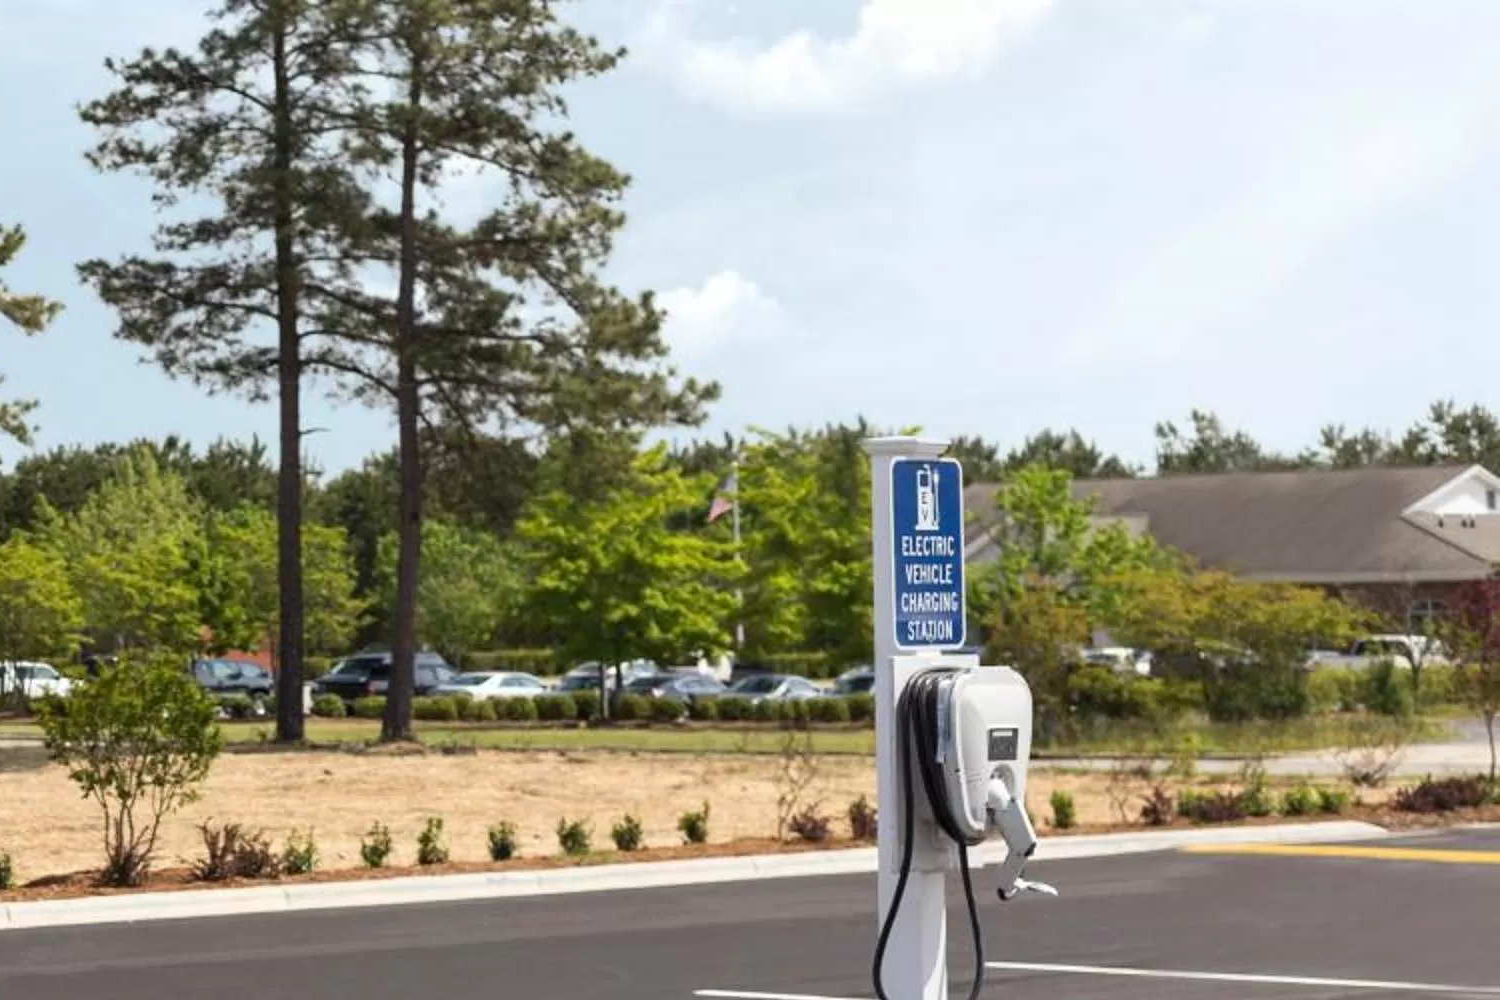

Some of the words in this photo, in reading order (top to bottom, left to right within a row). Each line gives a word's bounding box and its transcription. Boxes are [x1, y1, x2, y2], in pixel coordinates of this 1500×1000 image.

[901, 535, 955, 557] ELECTRIC
[905, 563, 953, 585] VEHICLE
[901, 591, 959, 614] CHARGING
[907, 620, 953, 641] STATION
